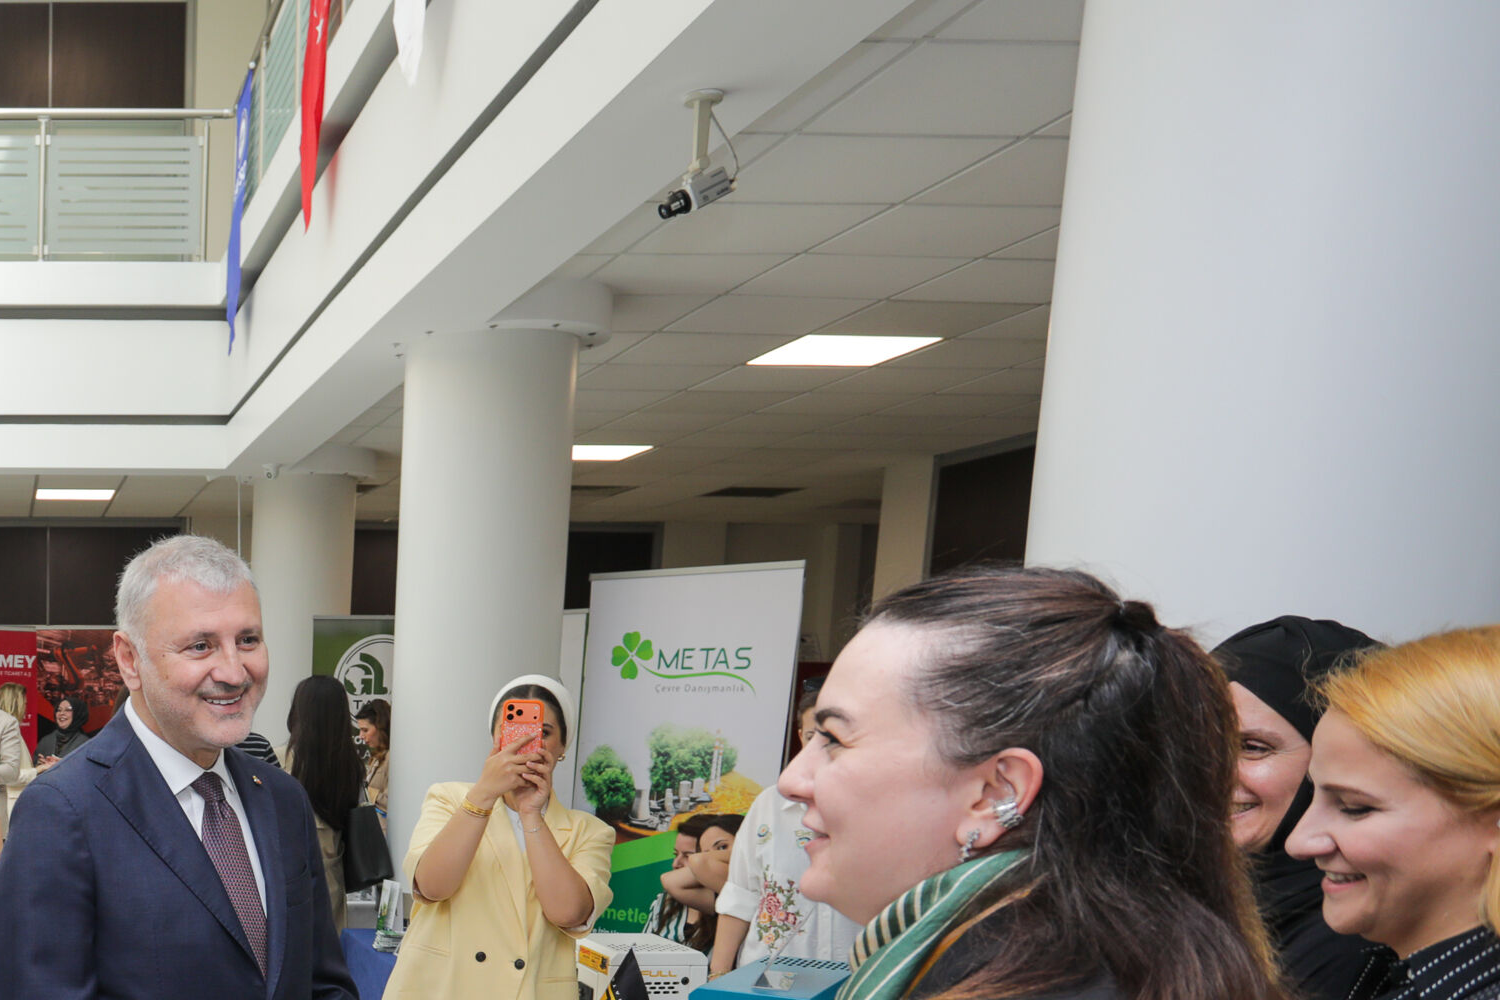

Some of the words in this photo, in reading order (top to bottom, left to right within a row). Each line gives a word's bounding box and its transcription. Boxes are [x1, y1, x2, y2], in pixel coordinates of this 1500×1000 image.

[656, 647, 753, 670] METAS
[654, 684, 681, 694] Çevre
[684, 684, 746, 694] Danışmanlık
[640, 970, 677, 978] FULL
